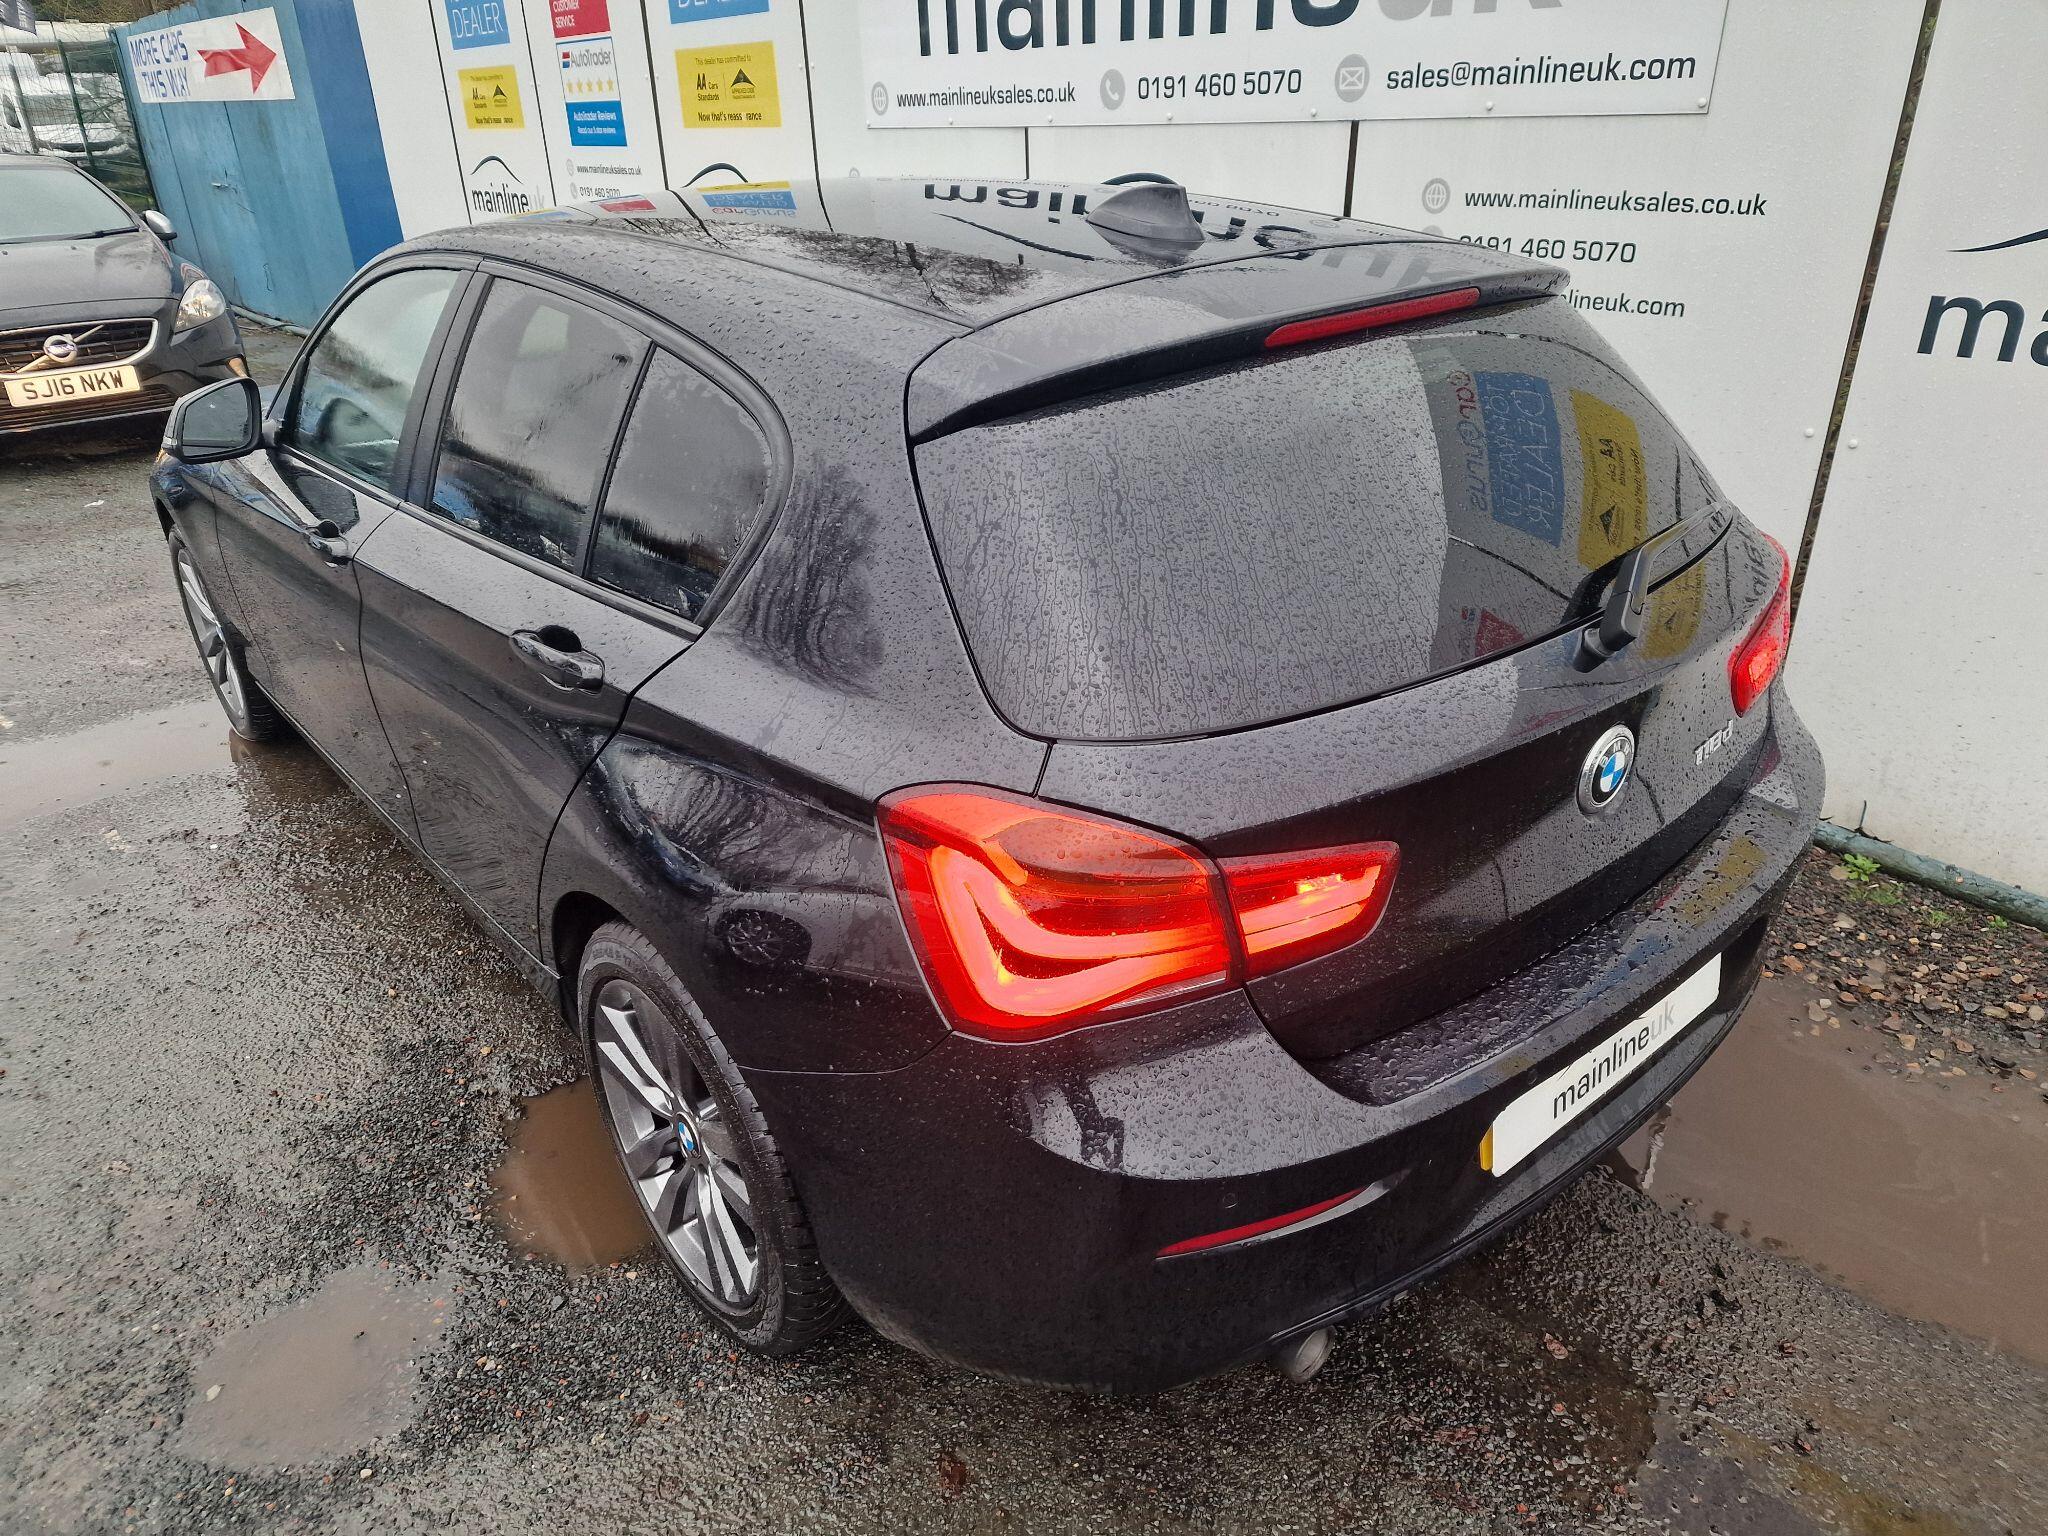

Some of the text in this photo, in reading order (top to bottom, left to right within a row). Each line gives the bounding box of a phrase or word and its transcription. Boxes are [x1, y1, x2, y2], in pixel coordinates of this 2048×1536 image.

[452, 2, 504, 38] DEALER
[555, 14, 575, 28] SERVICE
[130, 30, 189, 67] MORE CARS
[571, 48, 612, 68] AutoTrader
[141, 67, 190, 97] THIS WAY
[696, 73, 719, 90] AA Cars
[1137, 69, 1302, 99] 0191 460 5070
[1385, 52, 1697, 90] sales@mainlineuk.com
[697, 93, 719, 101] Standards
[896, 81, 1076, 108] www.mainlineuksales.co.uk
[698, 112, 710, 122] Now
[711, 111, 727, 122] that's
[577, 164, 642, 176] www.mainlineuksales.co.uk
[580, 187, 594, 197] 0191
[595, 187, 606, 198] 460
[1464, 189, 1768, 216] www.mainlineuksales.co.uk
[1521, 238, 1566, 259] 460
[1573, 240, 1637, 263] 5070
[22, 370, 124, 400] SJ16 NKW
[1694, 719, 1734, 766] 118d
[1553, 999, 1676, 1119] mainlineuk
